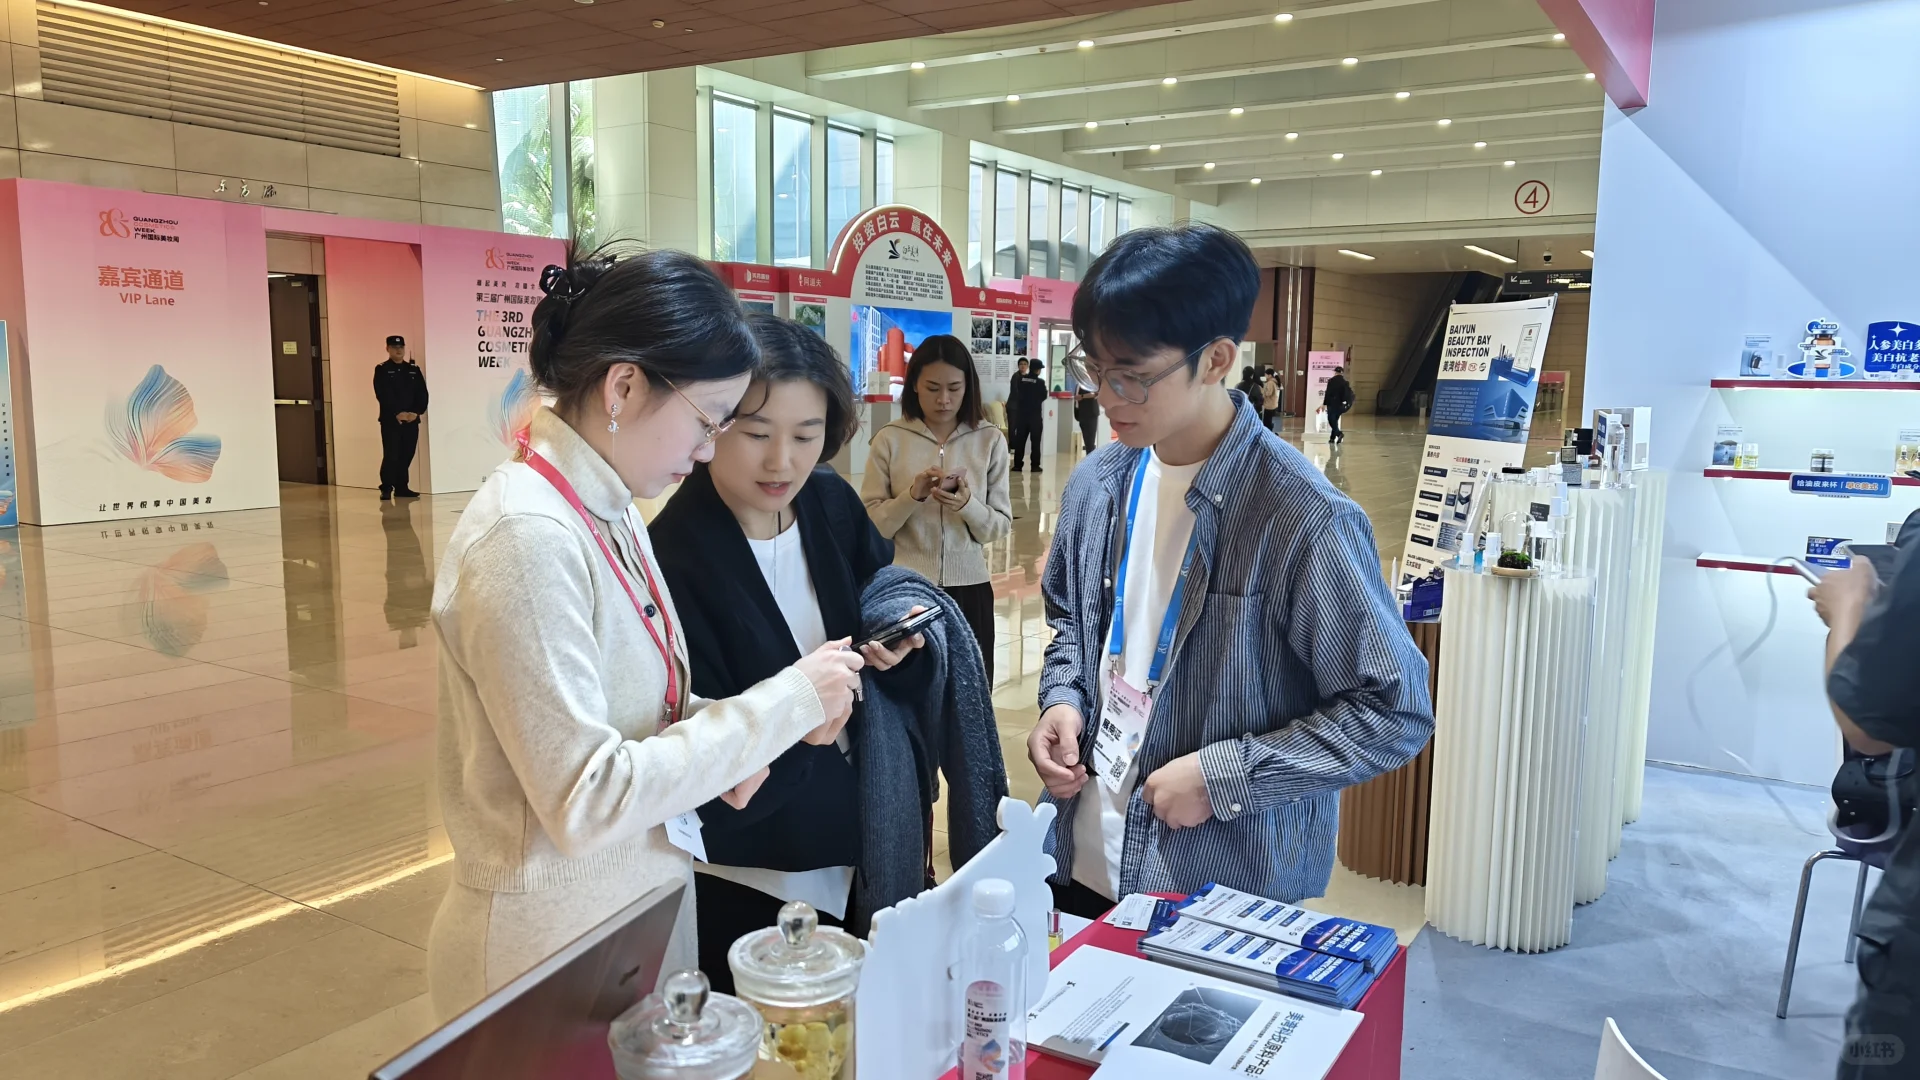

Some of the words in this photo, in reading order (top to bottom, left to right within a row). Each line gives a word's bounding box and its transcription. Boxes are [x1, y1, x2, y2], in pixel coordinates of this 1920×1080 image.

[133, 216, 179, 226] GUANGZHOU
[133, 222, 177, 231] COSMETICS
[134, 232, 180, 244] 广州国际美妆周
[853, 211, 900, 254] 投资白云
[911, 215, 953, 268] 赢在未来
[98, 265, 185, 291] 嘉宾通道
[119, 292, 142, 305] VIP
[145, 294, 176, 307] Lane
[476, 309, 499, 322] THE
[501, 310, 524, 323] 3RD
[1449, 324, 1476, 335] BAIYUN
[1447, 335, 1476, 346] BEAUTY
[1477, 335, 1491, 346] BAY
[1445, 346, 1490, 358] INSPECTION
[478, 356, 511, 368] WEEK
[1442, 360, 1467, 373] 美湾检测
